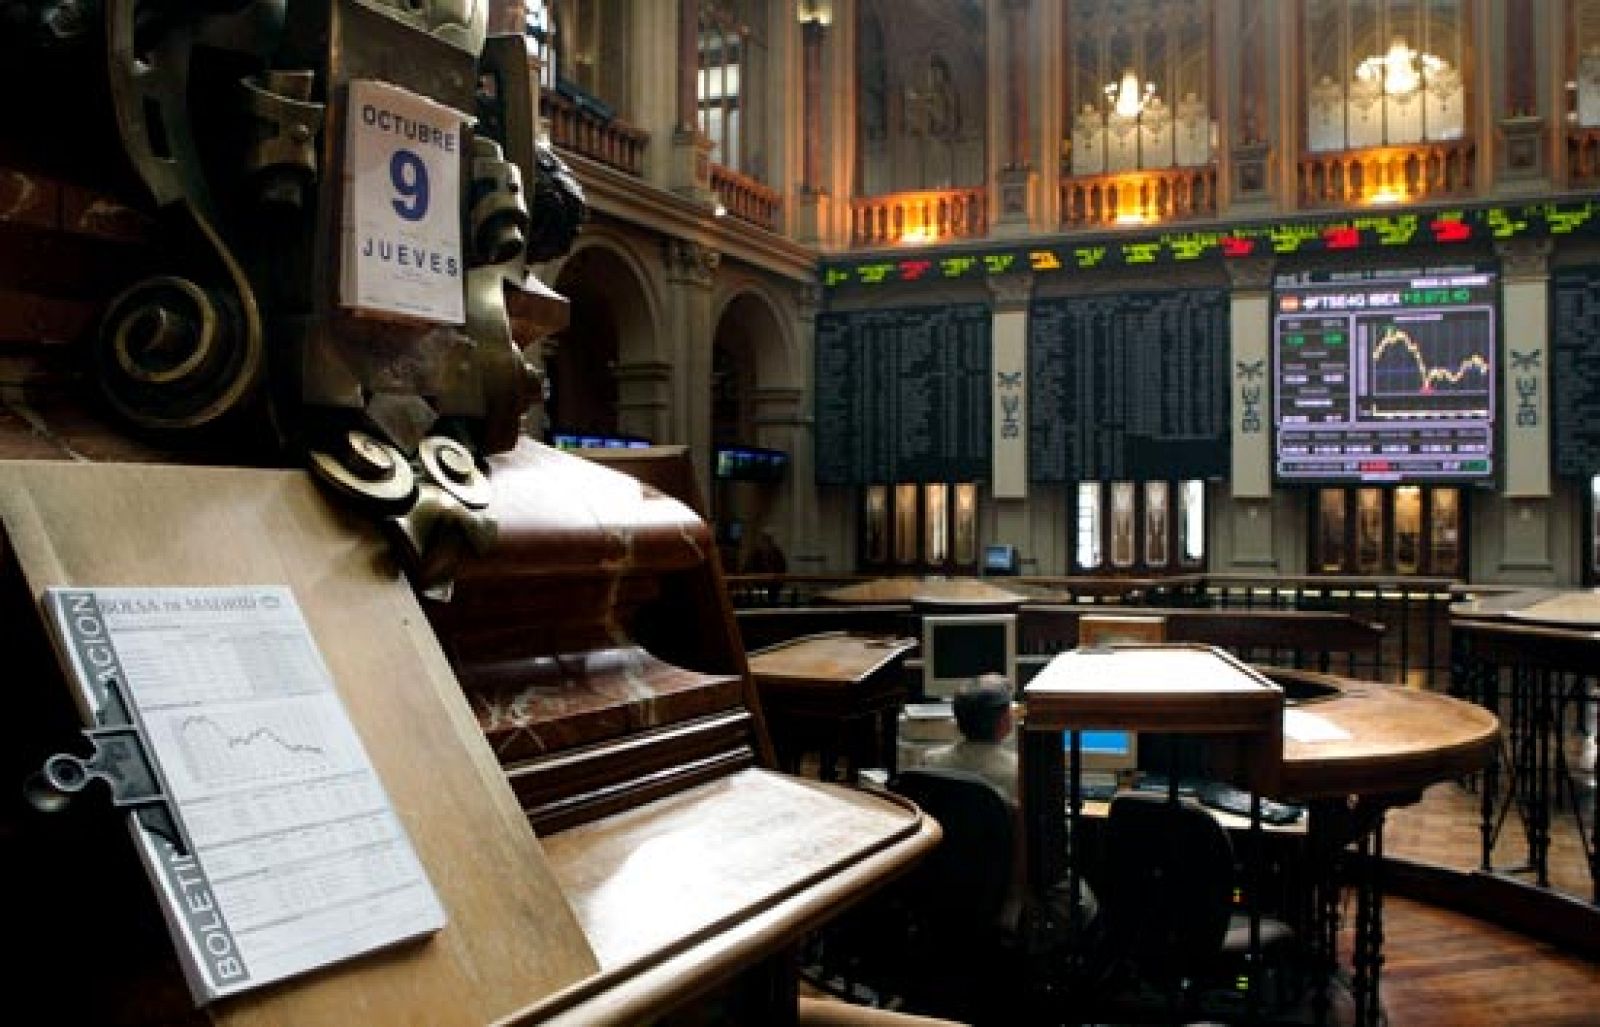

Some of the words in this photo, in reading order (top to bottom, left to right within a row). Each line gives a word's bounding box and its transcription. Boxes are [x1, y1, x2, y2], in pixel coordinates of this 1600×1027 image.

[363, 104, 456, 152] OCTUBRE
[390, 148, 428, 221] 9
[363, 238, 458, 276] JUEVES
[186, 595, 257, 611] MADRID
